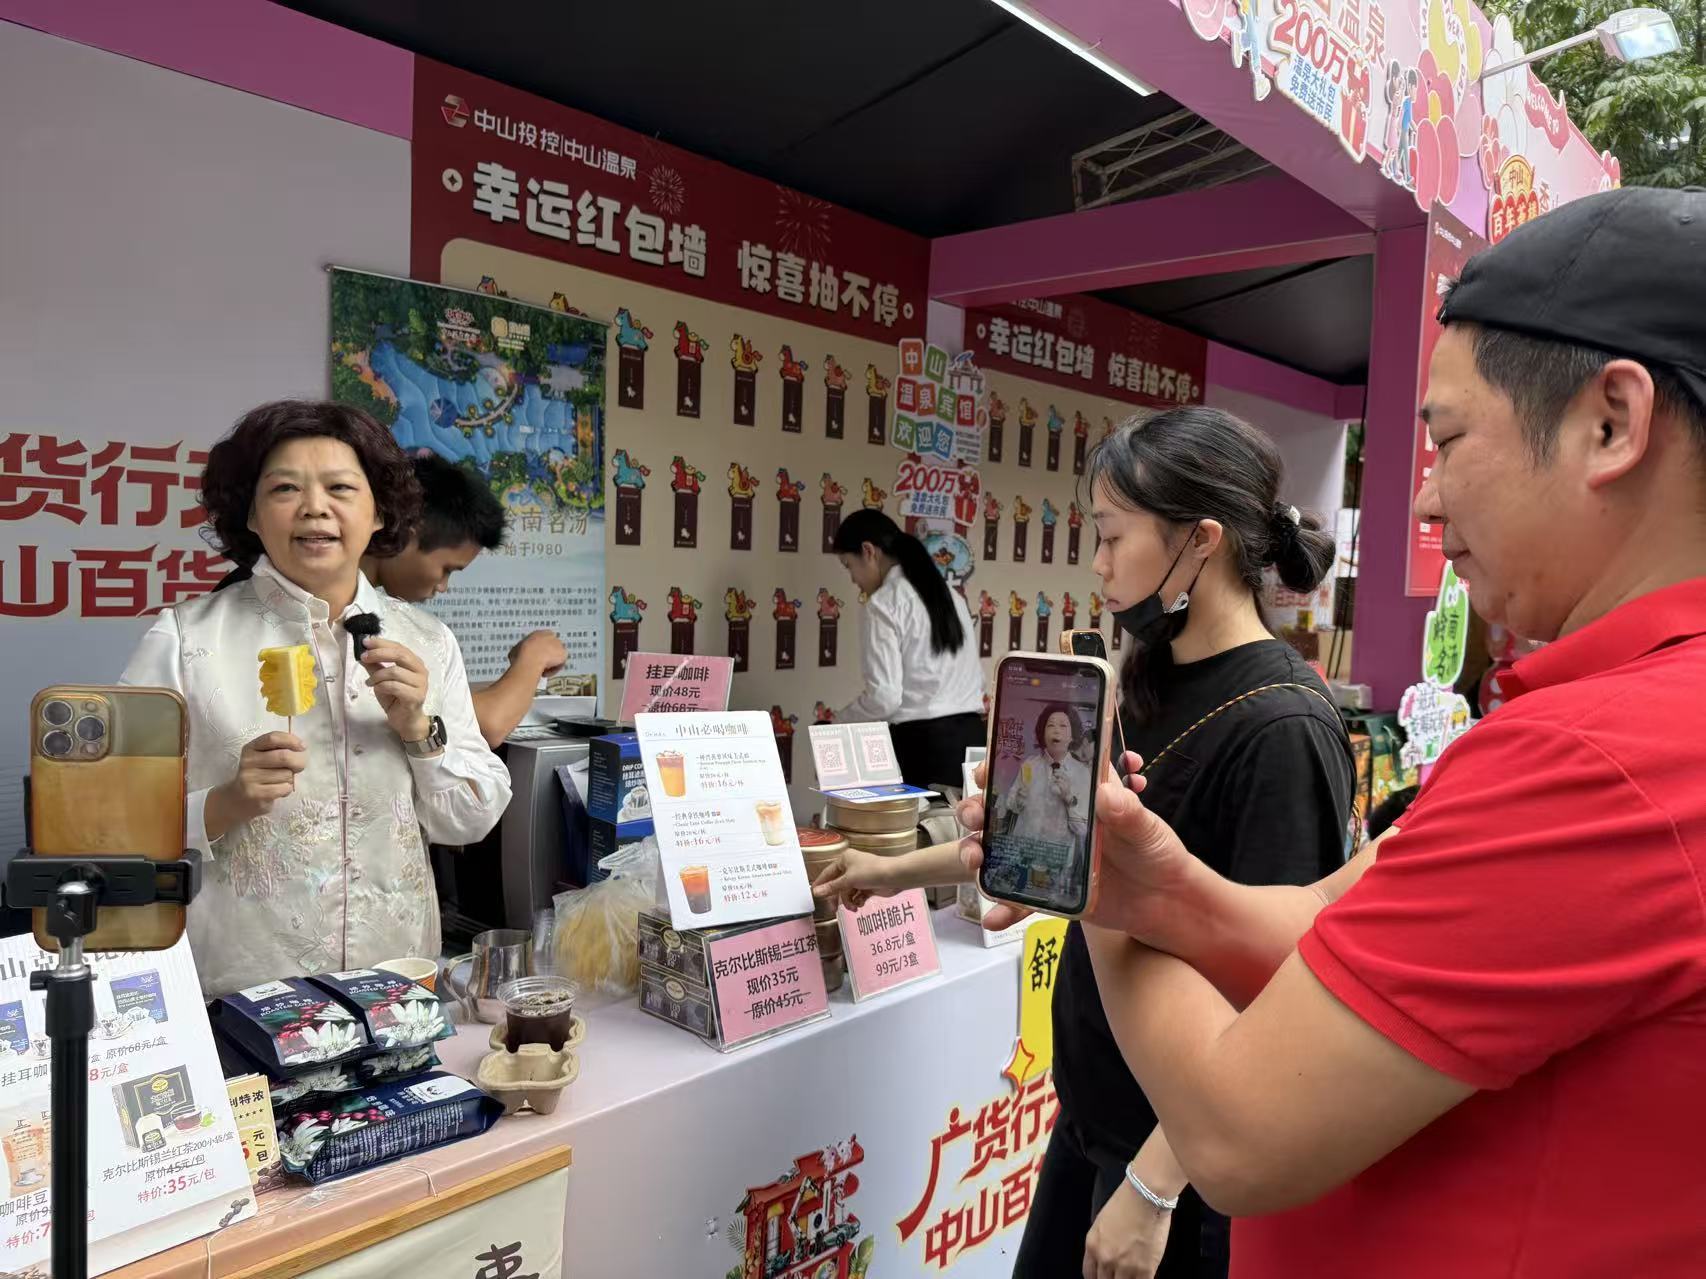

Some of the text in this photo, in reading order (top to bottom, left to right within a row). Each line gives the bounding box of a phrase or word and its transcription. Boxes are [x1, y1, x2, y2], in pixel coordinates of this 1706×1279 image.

[1274, 0, 1348, 84] 200万
[1294, 54, 1336, 103] 温泉大礼包
[1290, 76, 1334, 122] 免费送市民
[1508, 168, 1525, 189] 中山
[473, 160, 899, 328] 幸运红包墙 惊喜抽不停
[904, 347, 942, 376] 中山
[988, 316, 1191, 403] 幸运红包墙 惊喜抽不停
[896, 464, 959, 493] 200万
[646, 664, 710, 682] 挂耳咖啡
[650, 685, 701, 698] 现价48元
[675, 722, 748, 737] 中山必喝咖啡
[856, 902, 915, 936] 咖啡脆片
[714, 933, 818, 978] 克尔比斯锡兰红茶
[870, 930, 917, 956] 36.8元/盒
[875, 952, 919, 977] 99元/3盒
[1028, 936, 1058, 993] 舒
[746, 966, 800, 996] 现价35元
[751, 988, 803, 1020] 原价45元
[106, 1037, 168, 1060] 原价68元/盒
[144, 1154, 206, 1183] 原价45元/包
[137, 1168, 216, 1203] 特价:35元/包
[0, 1189, 48, 1217] 咖啡豆
[924, 1152, 1046, 1269] 中山百
